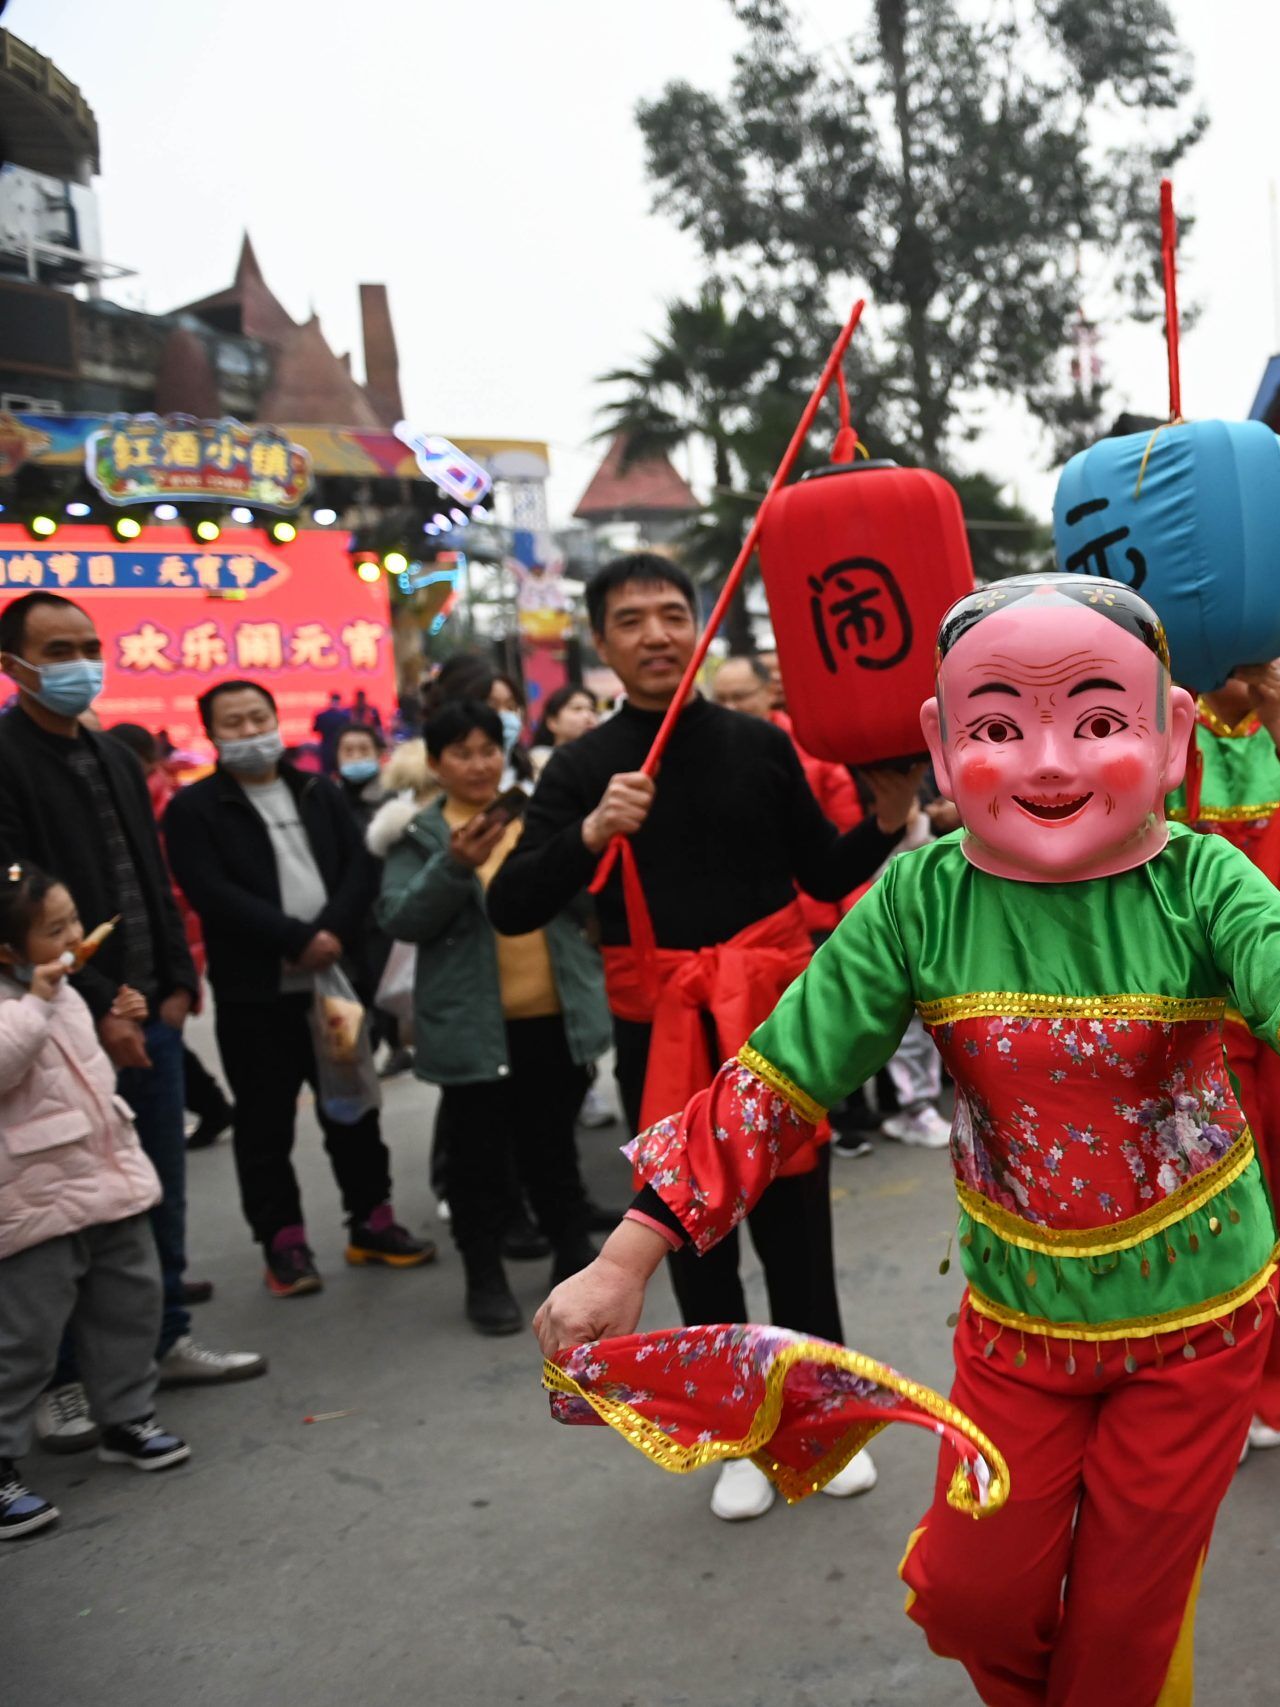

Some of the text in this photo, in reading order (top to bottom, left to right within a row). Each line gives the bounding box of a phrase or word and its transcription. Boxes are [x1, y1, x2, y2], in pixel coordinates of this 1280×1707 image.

[113, 431, 289, 482] 红酒小镇
[0, 553, 256, 588] 的节日·元宵节
[1065, 497, 1147, 590] 元
[807, 555, 914, 675] 闹
[118, 619, 383, 673] 欢乐闹元宵
